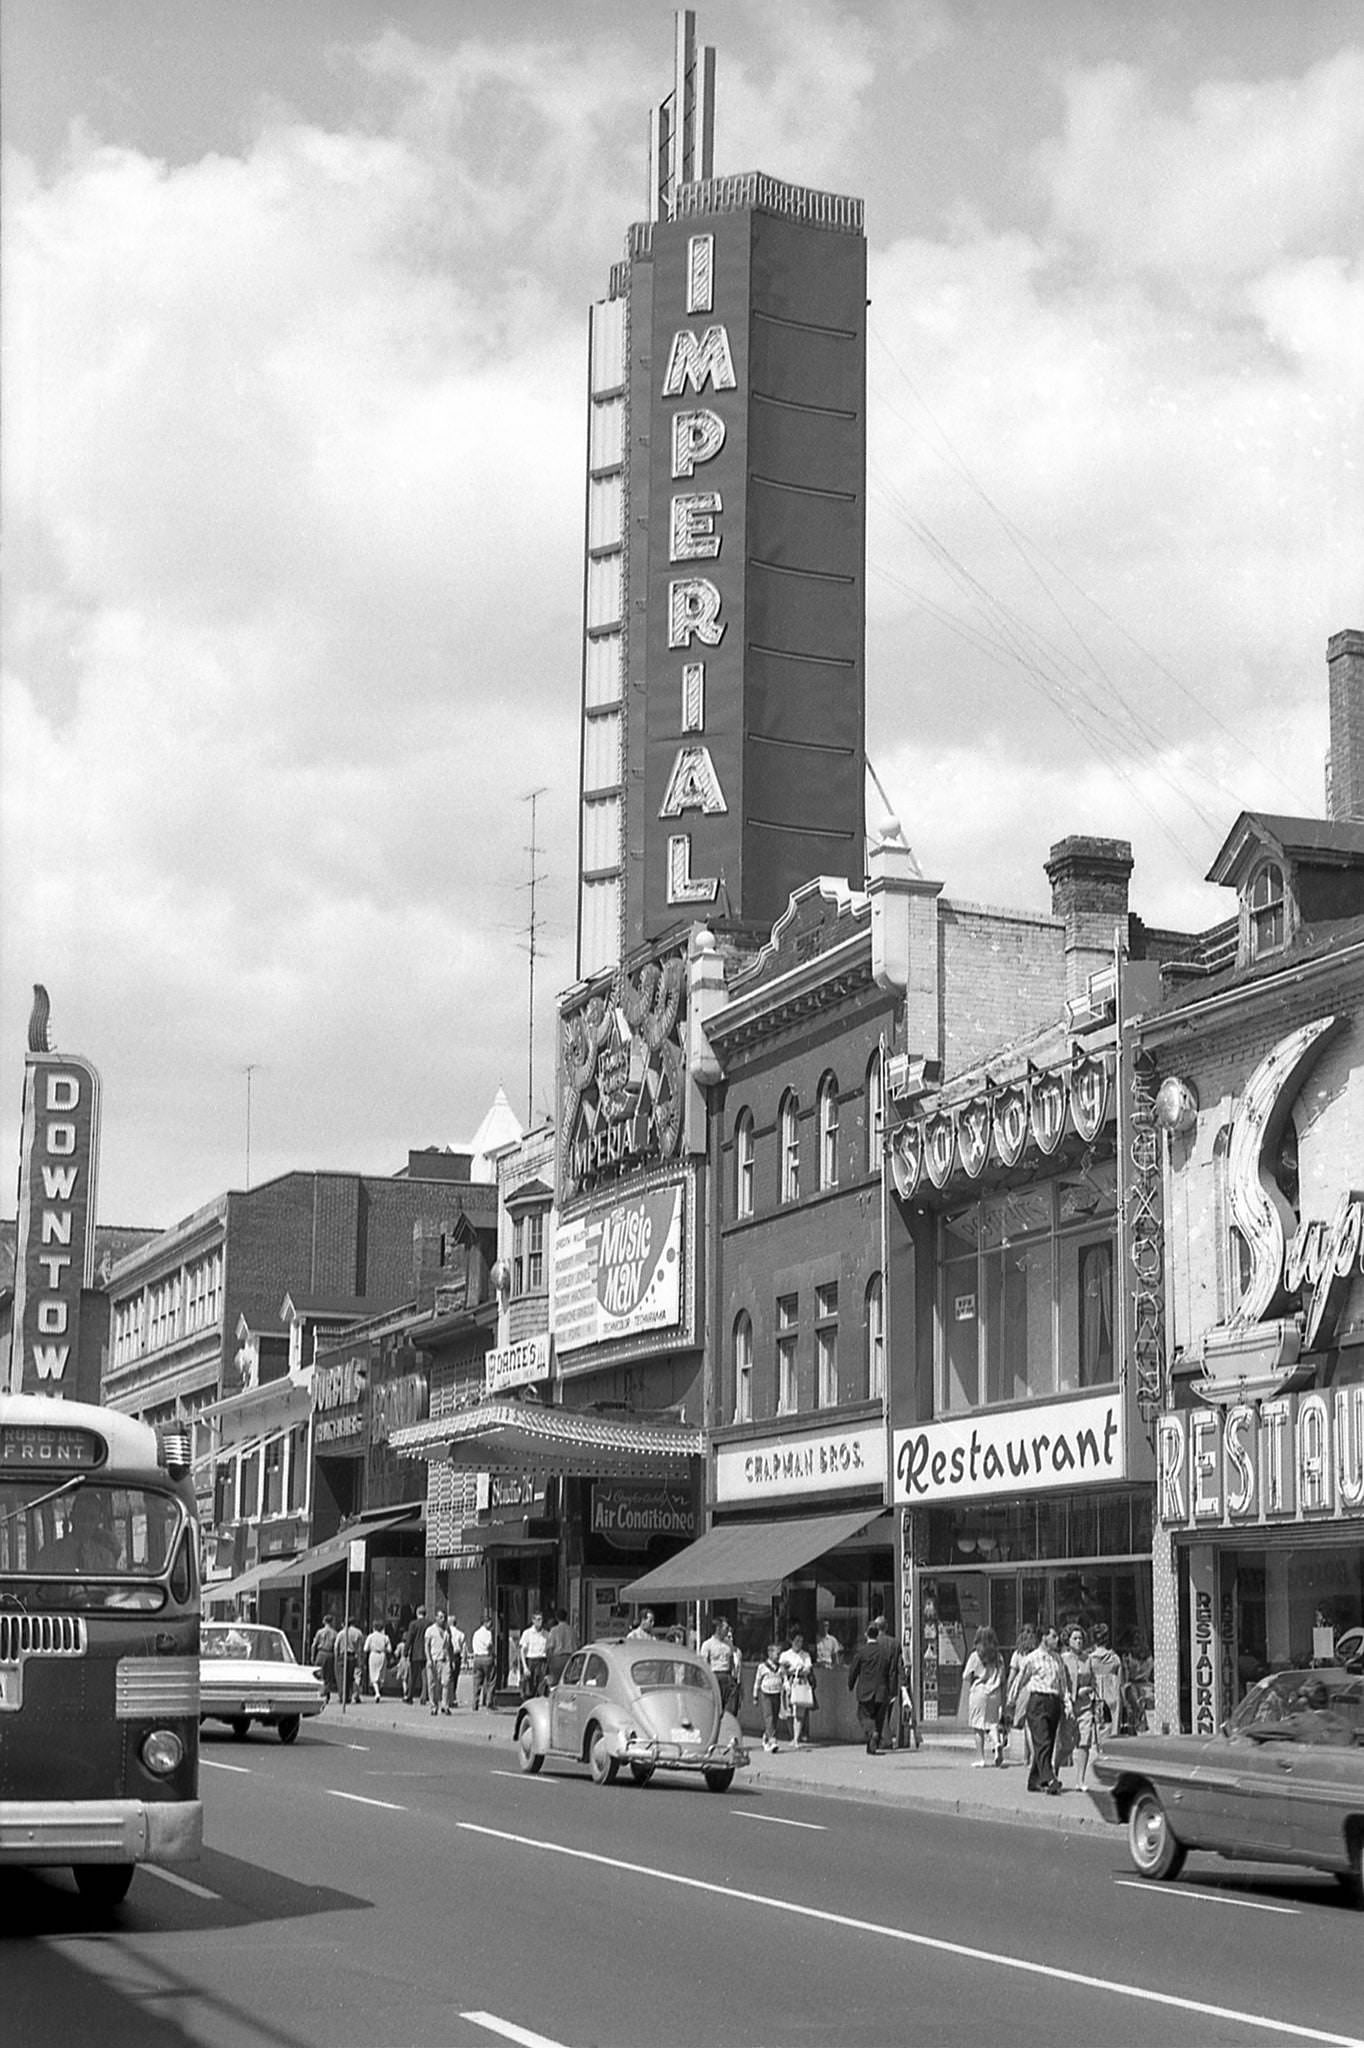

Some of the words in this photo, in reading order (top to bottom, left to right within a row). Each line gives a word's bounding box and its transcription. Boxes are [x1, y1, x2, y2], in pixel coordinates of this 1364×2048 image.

[658, 234, 737, 904] IMPERIAL
[33, 1073, 80, 1400] DOWNTOW
[497, 1342, 537, 1375] DANTE'S
[3, 1446, 85, 1460] FRONT
[744, 1448, 814, 1484] CHAPMAN
[896, 1407, 1119, 1495] Restaurant
[595, 1502, 616, 1529] Air
[617, 1503, 695, 1530] Conditioned
